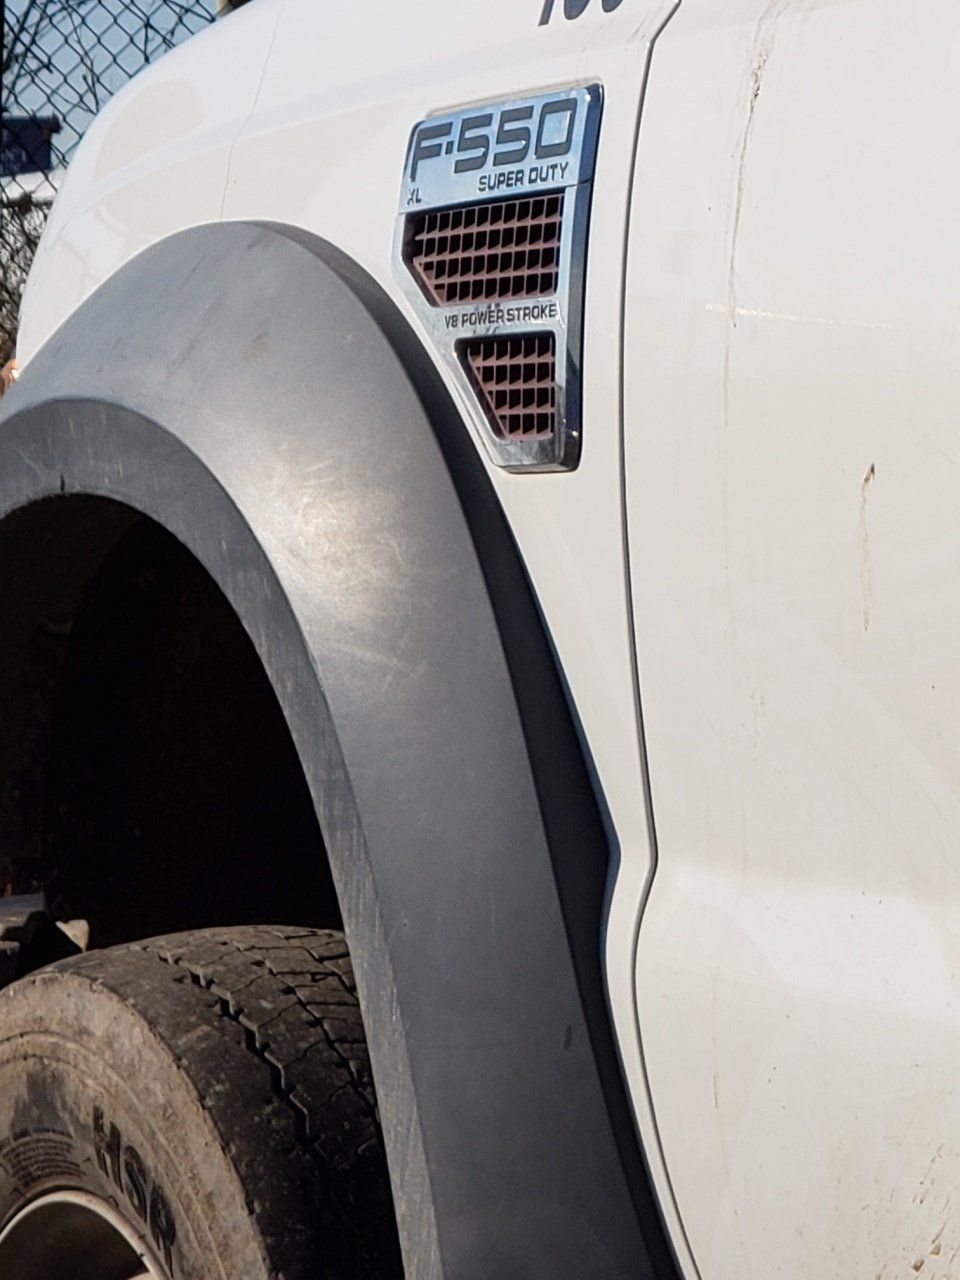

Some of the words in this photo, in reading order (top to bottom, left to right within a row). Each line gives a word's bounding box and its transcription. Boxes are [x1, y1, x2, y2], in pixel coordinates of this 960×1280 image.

[409, 96, 578, 183] F-550
[477, 172, 525, 193] SUPER
[527, 161, 570, 185] DUTY
[406, 187, 423, 207] XL
[444, 314, 459, 330] V8
